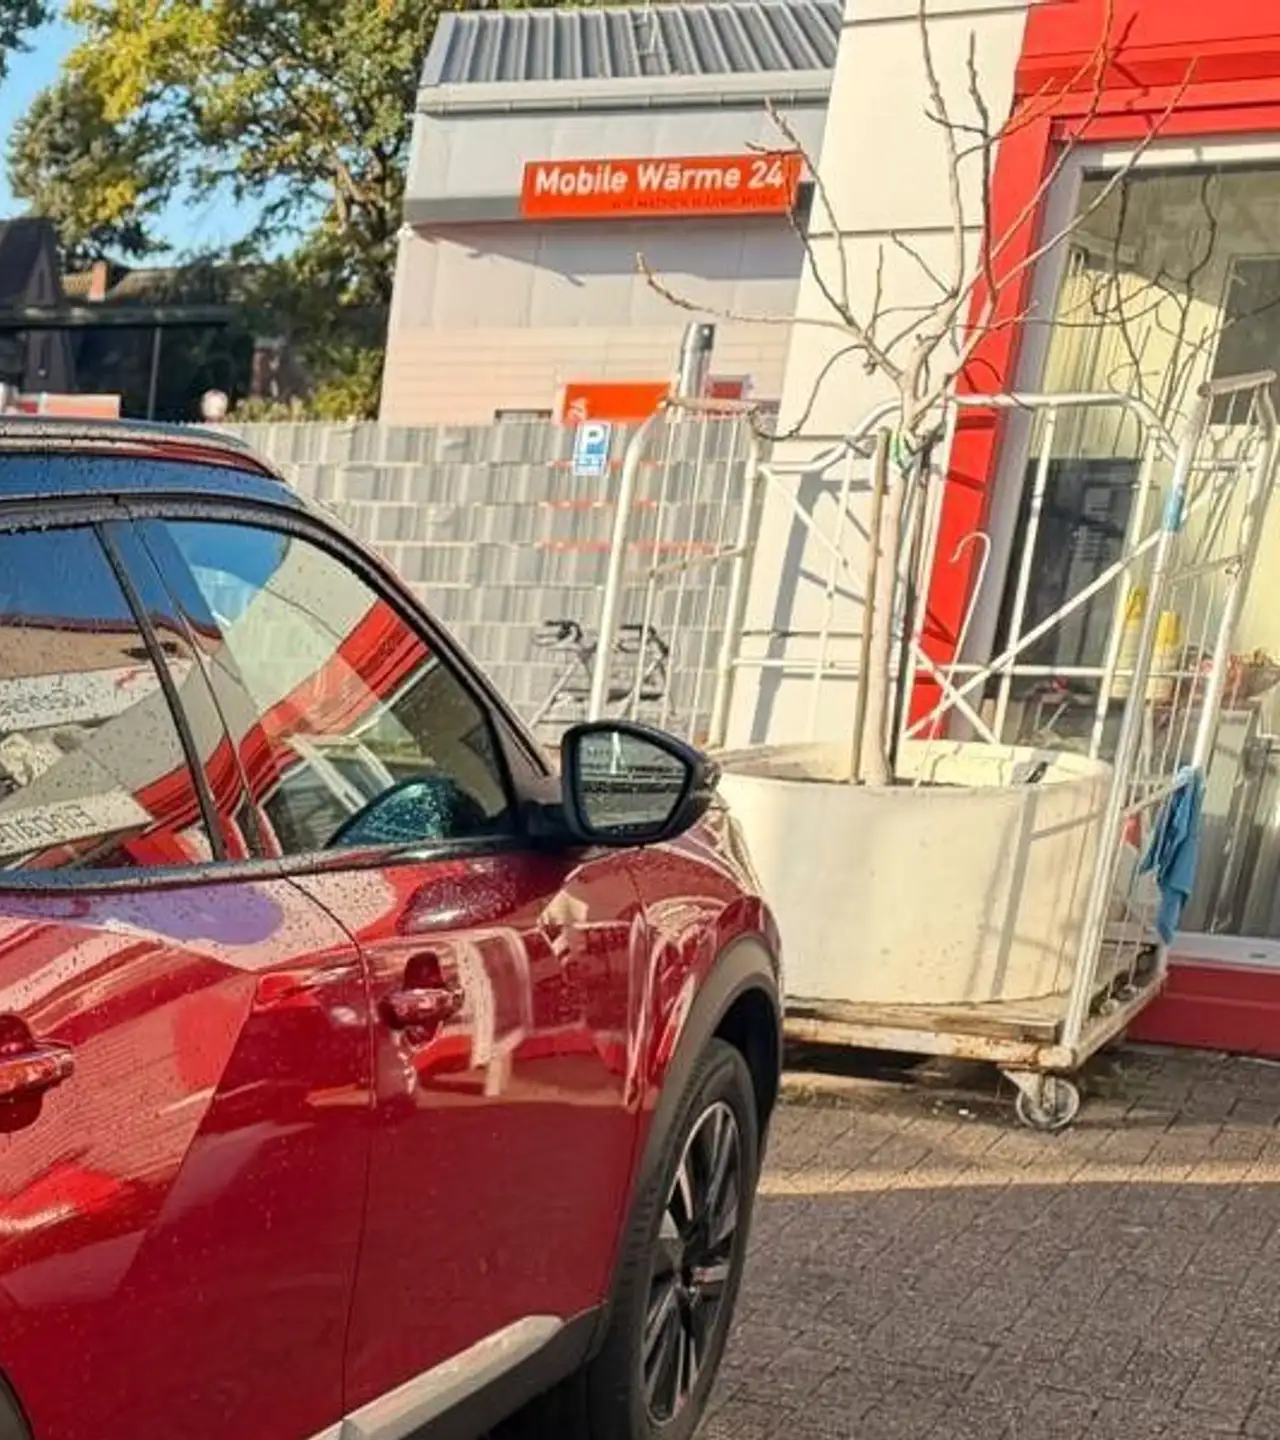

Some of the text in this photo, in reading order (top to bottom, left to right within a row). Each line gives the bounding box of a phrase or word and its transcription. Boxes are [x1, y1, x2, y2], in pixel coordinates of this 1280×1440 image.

[535, 159, 783, 197] Mobile Wärme 24
